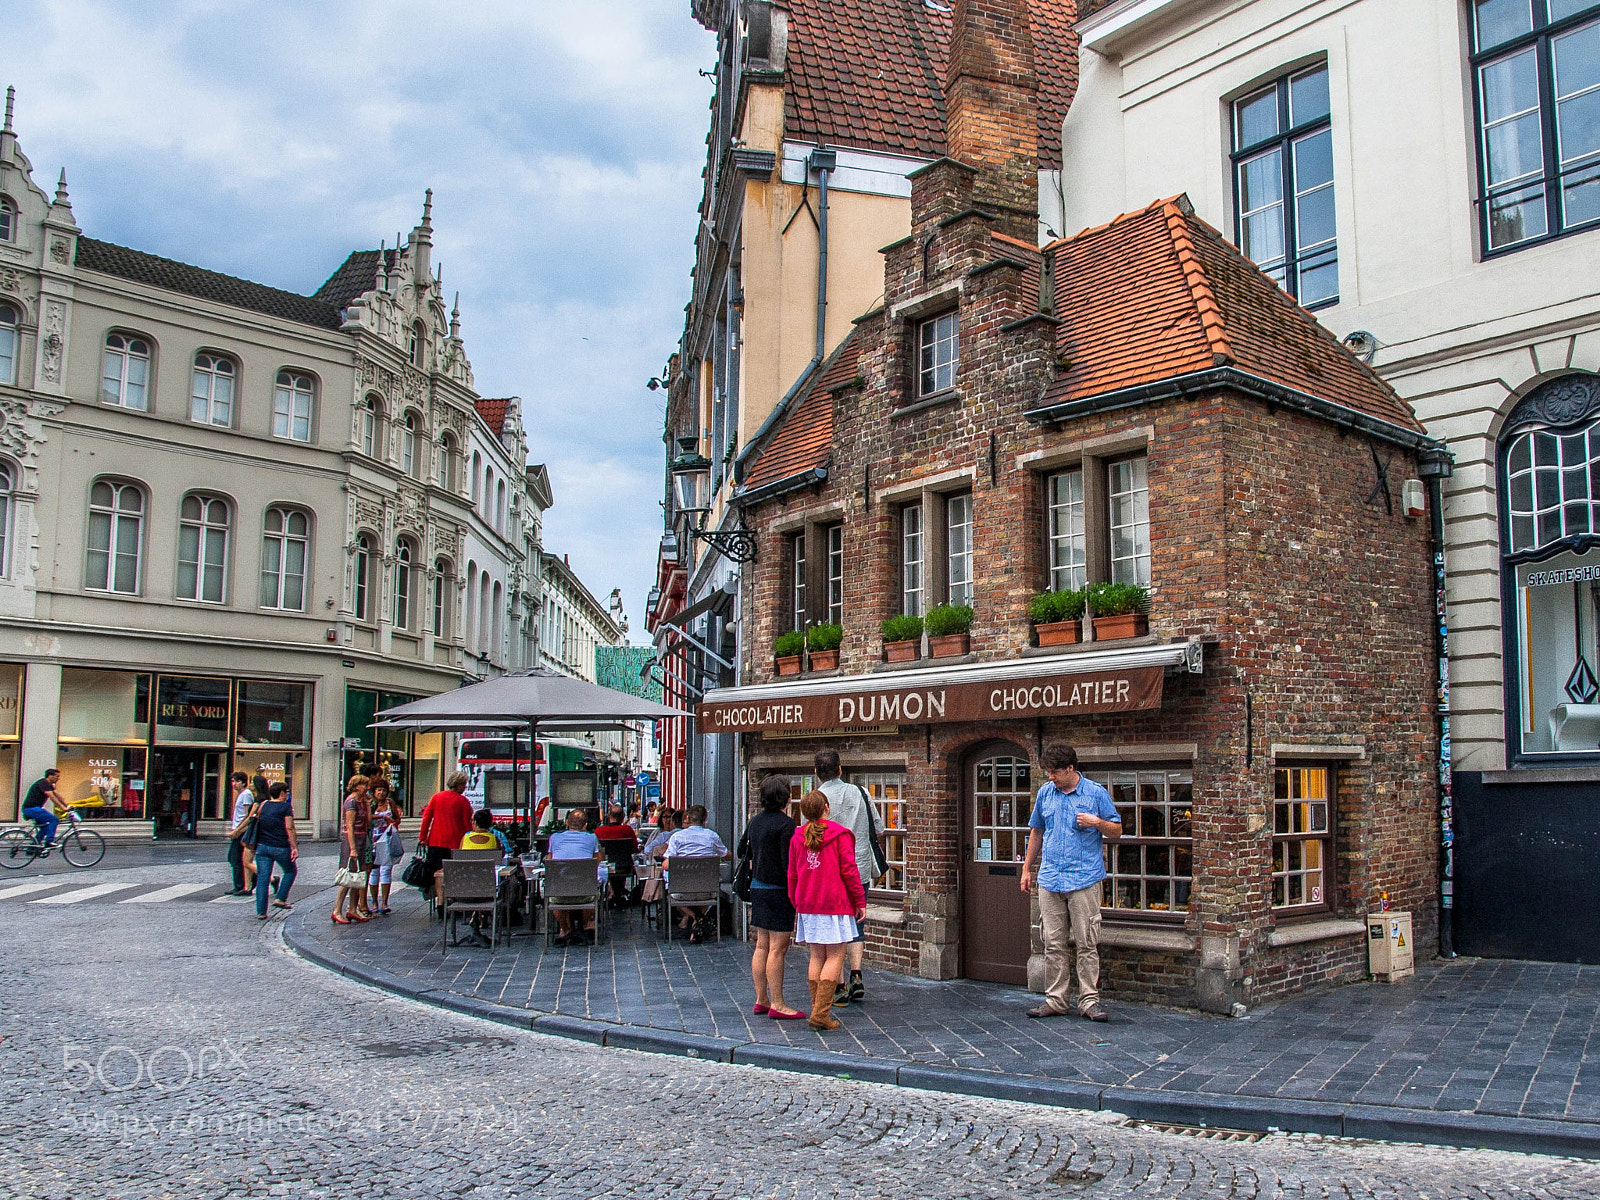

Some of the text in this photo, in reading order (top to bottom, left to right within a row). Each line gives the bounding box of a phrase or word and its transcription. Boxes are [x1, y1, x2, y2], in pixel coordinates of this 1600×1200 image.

[839, 690, 946, 722] DUMON
[990, 679, 1130, 711] CHOCOLATIER
[162, 703, 225, 719] RUE NORD
[715, 704, 803, 726] CHOCOLATIER
[88, 759, 118, 767] SALES
